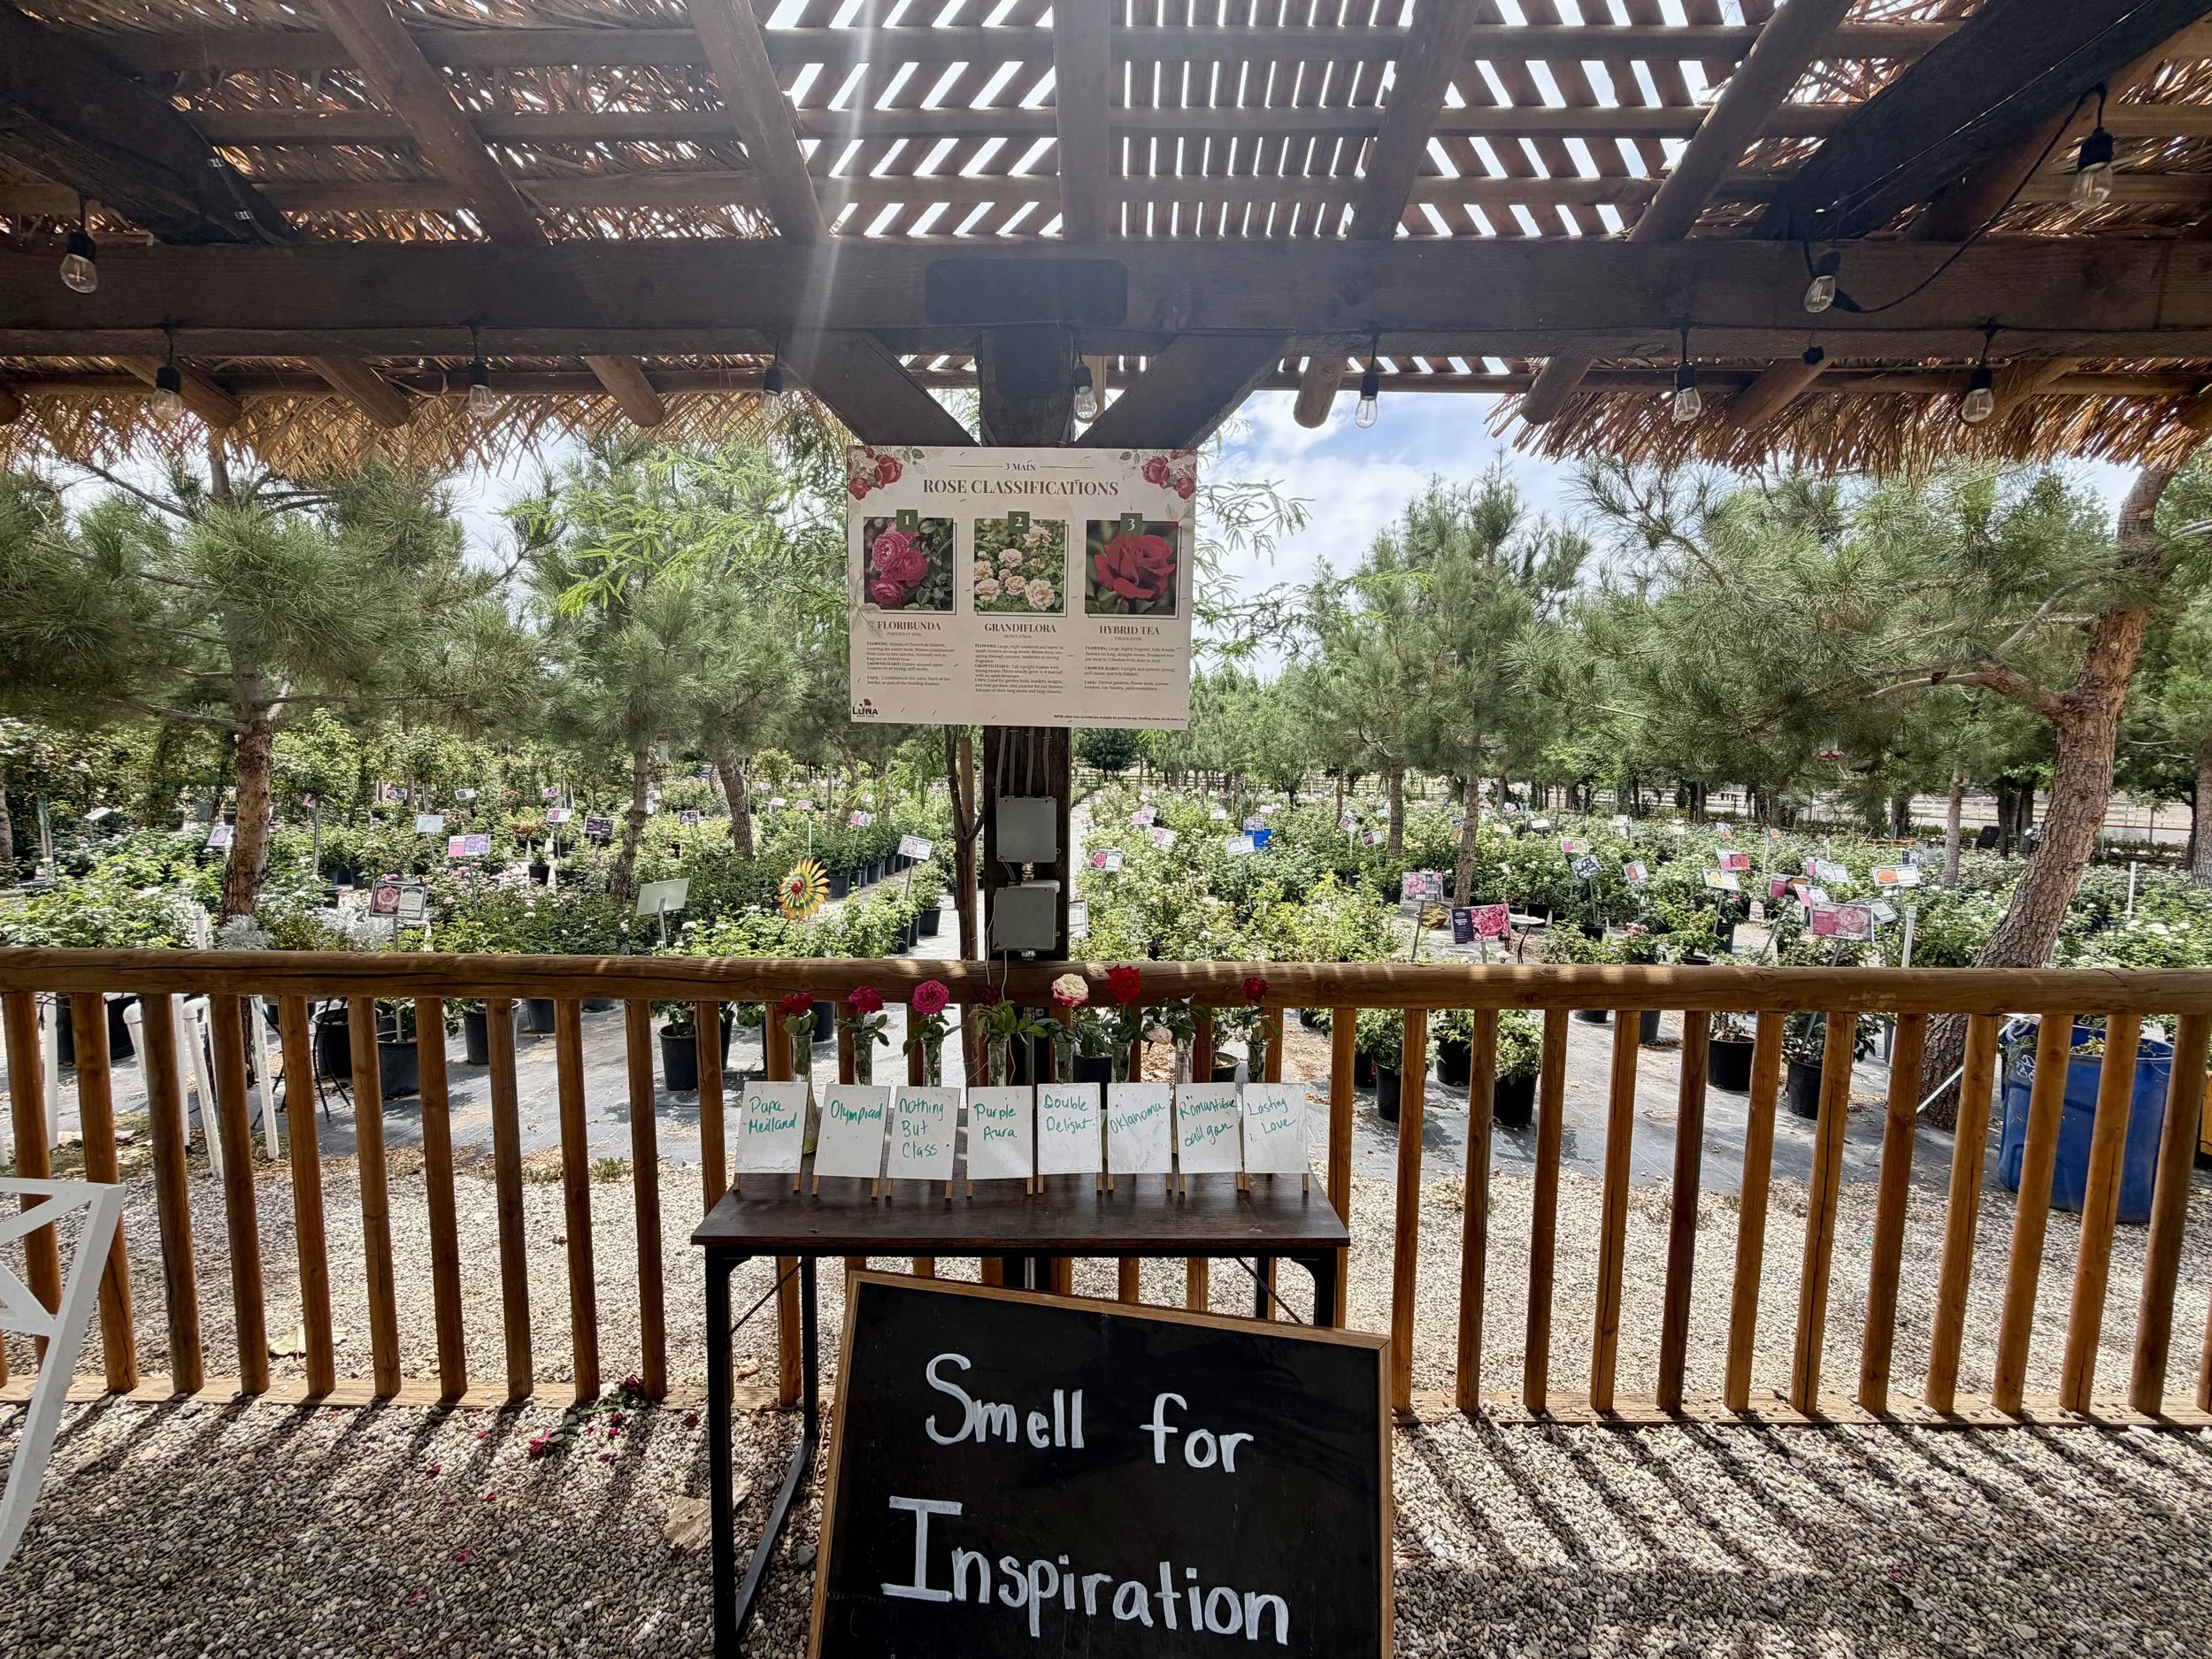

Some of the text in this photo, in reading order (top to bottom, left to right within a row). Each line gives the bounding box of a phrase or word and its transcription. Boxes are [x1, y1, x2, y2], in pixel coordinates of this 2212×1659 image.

[923, 479, 1118, 495] ROSE CLASSIFICATIONS
[904, 515, 910, 525] 1
[1015, 517, 1023, 527] 2
[1128, 518, 1135, 531] 3
[877, 621, 941, 630] FLORIBUNDA
[984, 623, 1056, 633] GRANDIFLORA
[1099, 626, 1160, 635] HYBRID TEA
[853, 706, 878, 715] LUNA
[749, 1096, 785, 1115] Papa
[1044, 1094, 1089, 1111] Double
[1247, 1096, 1288, 1116] Lasting
[831, 1100, 883, 1125] Olympiad
[973, 1103, 1017, 1121] Purple
[1110, 1103, 1165, 1133] Oklahoma
[749, 1112, 797, 1134] Meilland
[902, 1120, 928, 1137] But
[1046, 1116, 1094, 1134] Delight
[1261, 1118, 1297, 1134] Love
[984, 1126, 1017, 1141] Aura
[902, 1141, 938, 1159] Class
[926, 1353, 1254, 1473] Smell for
[880, 1495, 1289, 1646] Inspiration
